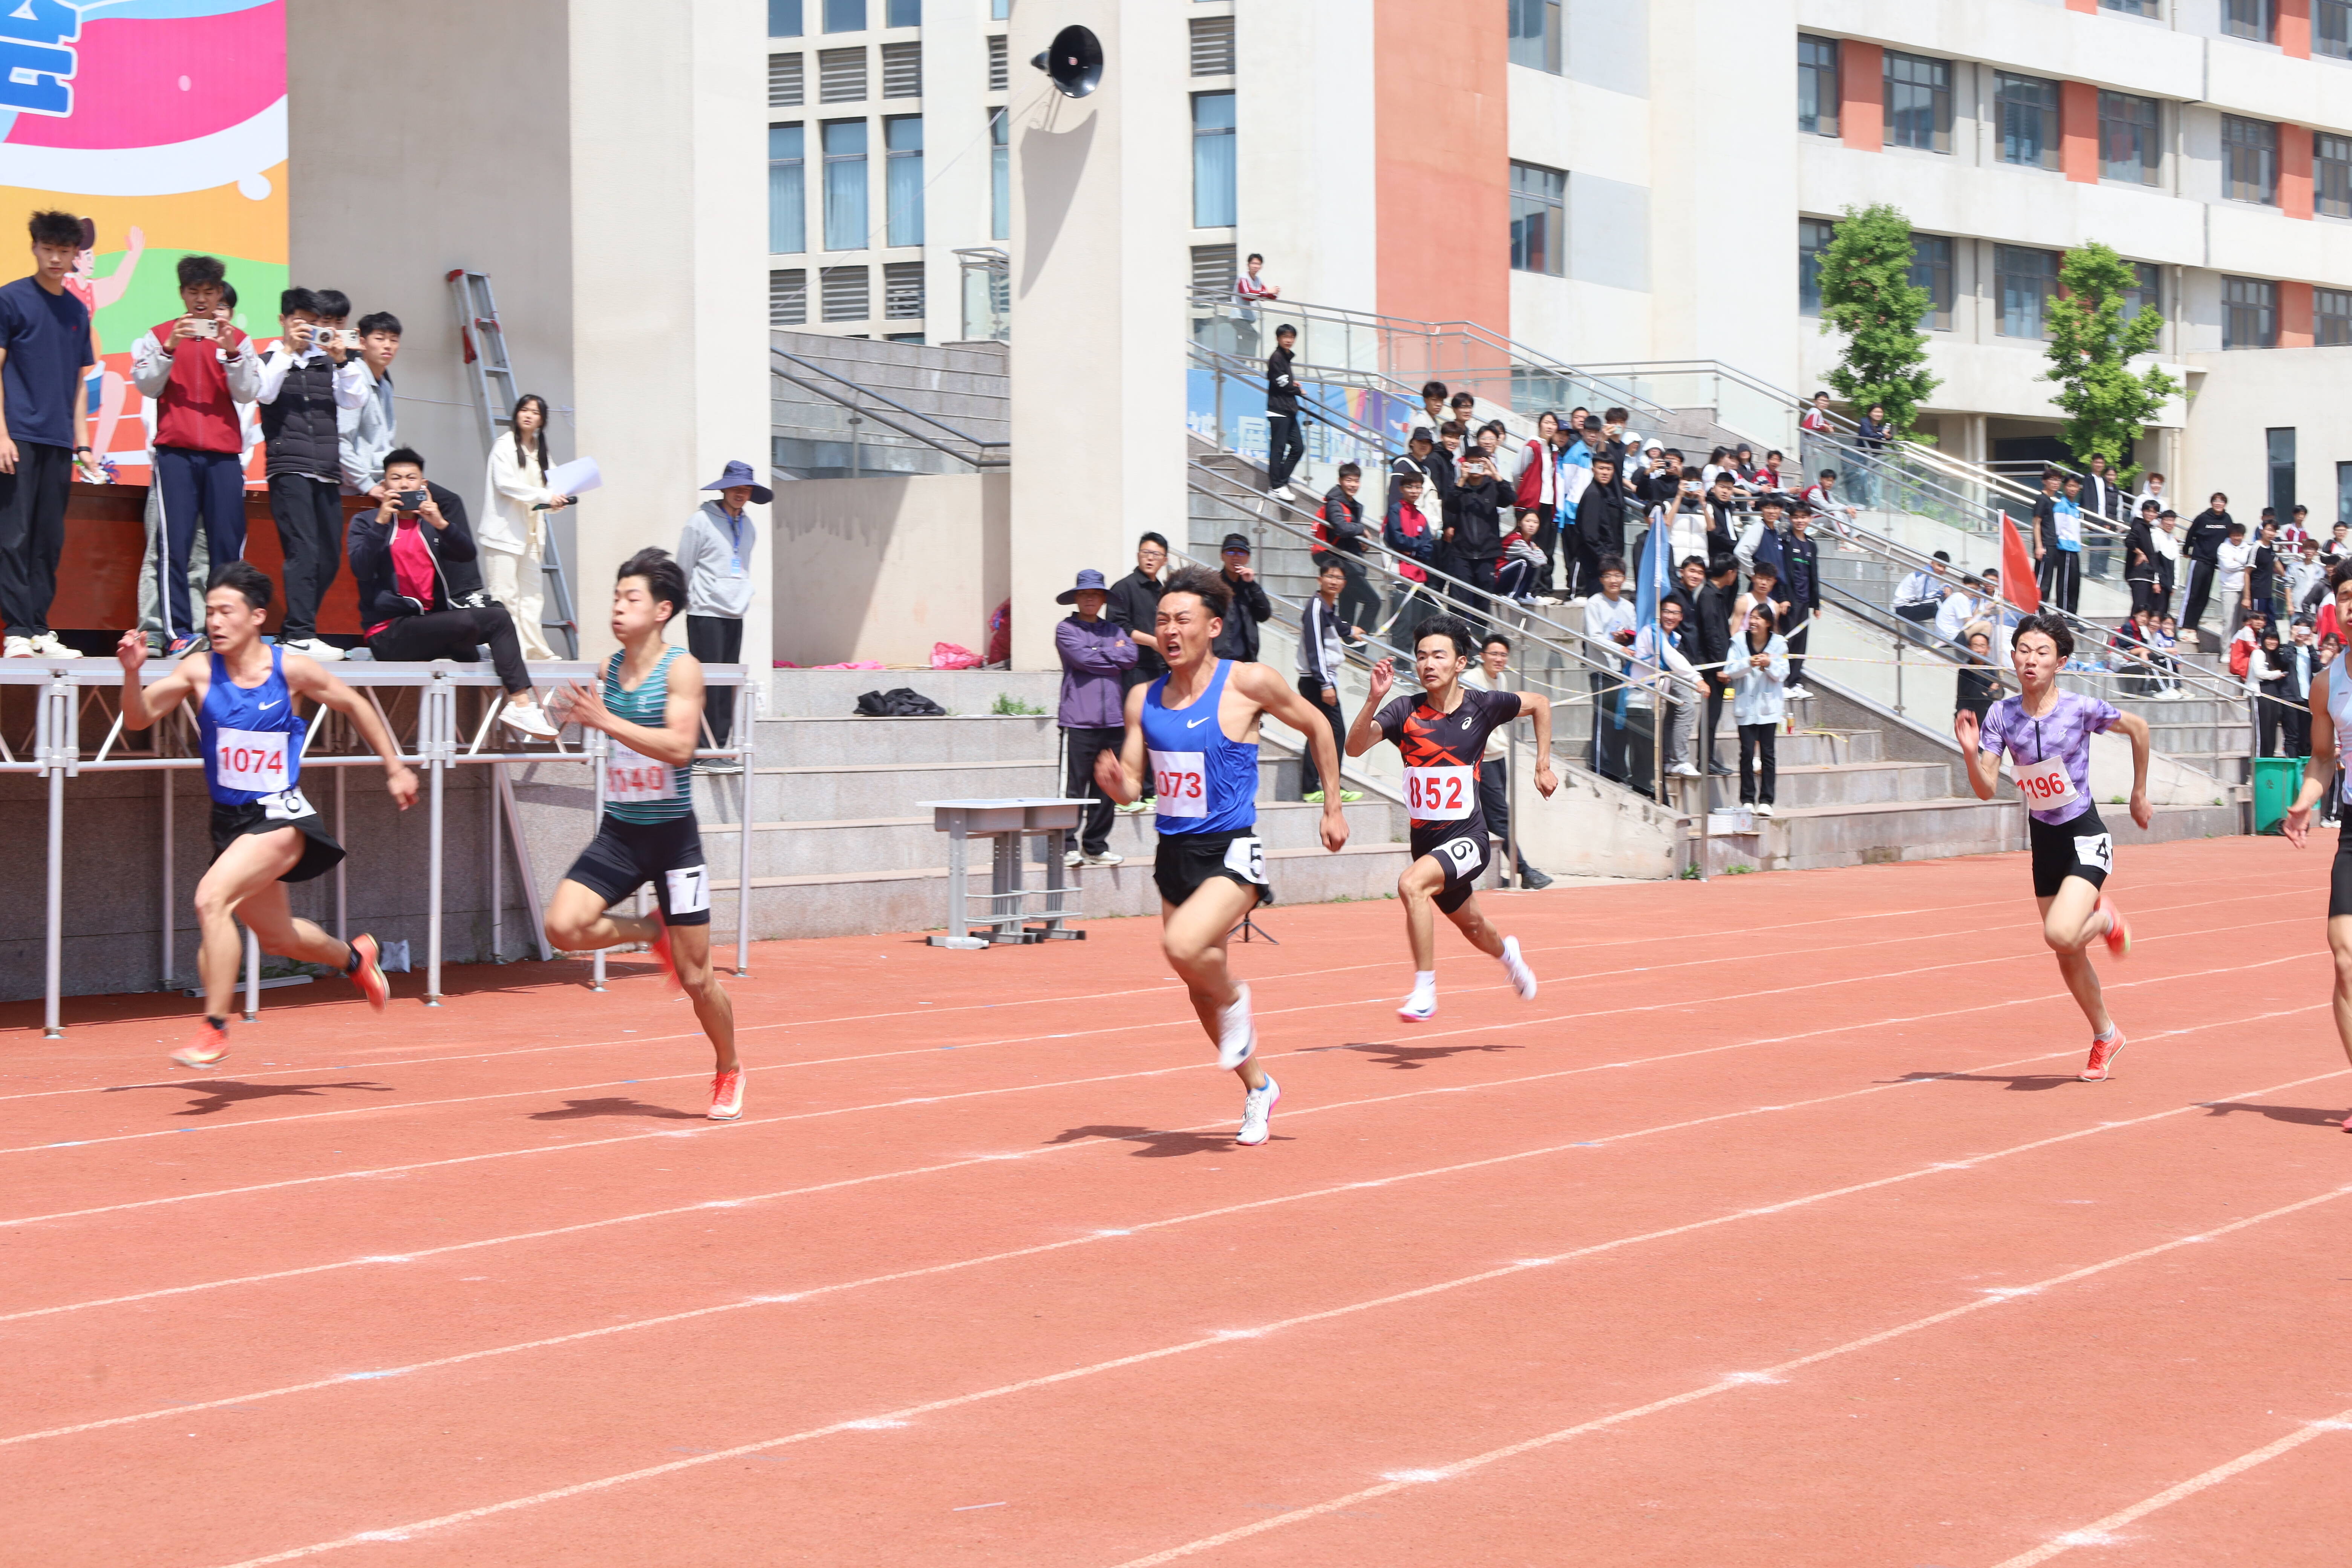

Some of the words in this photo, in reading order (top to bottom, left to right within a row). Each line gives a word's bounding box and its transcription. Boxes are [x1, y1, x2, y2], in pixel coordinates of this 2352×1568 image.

[219, 747, 284, 774] 1074
[1152, 770, 1201, 798] 073
[1410, 776, 1462, 810] 852
[1450, 841, 1473, 860] 6
[2096, 838, 2109, 866] 4
[686, 870, 703, 906] 7
